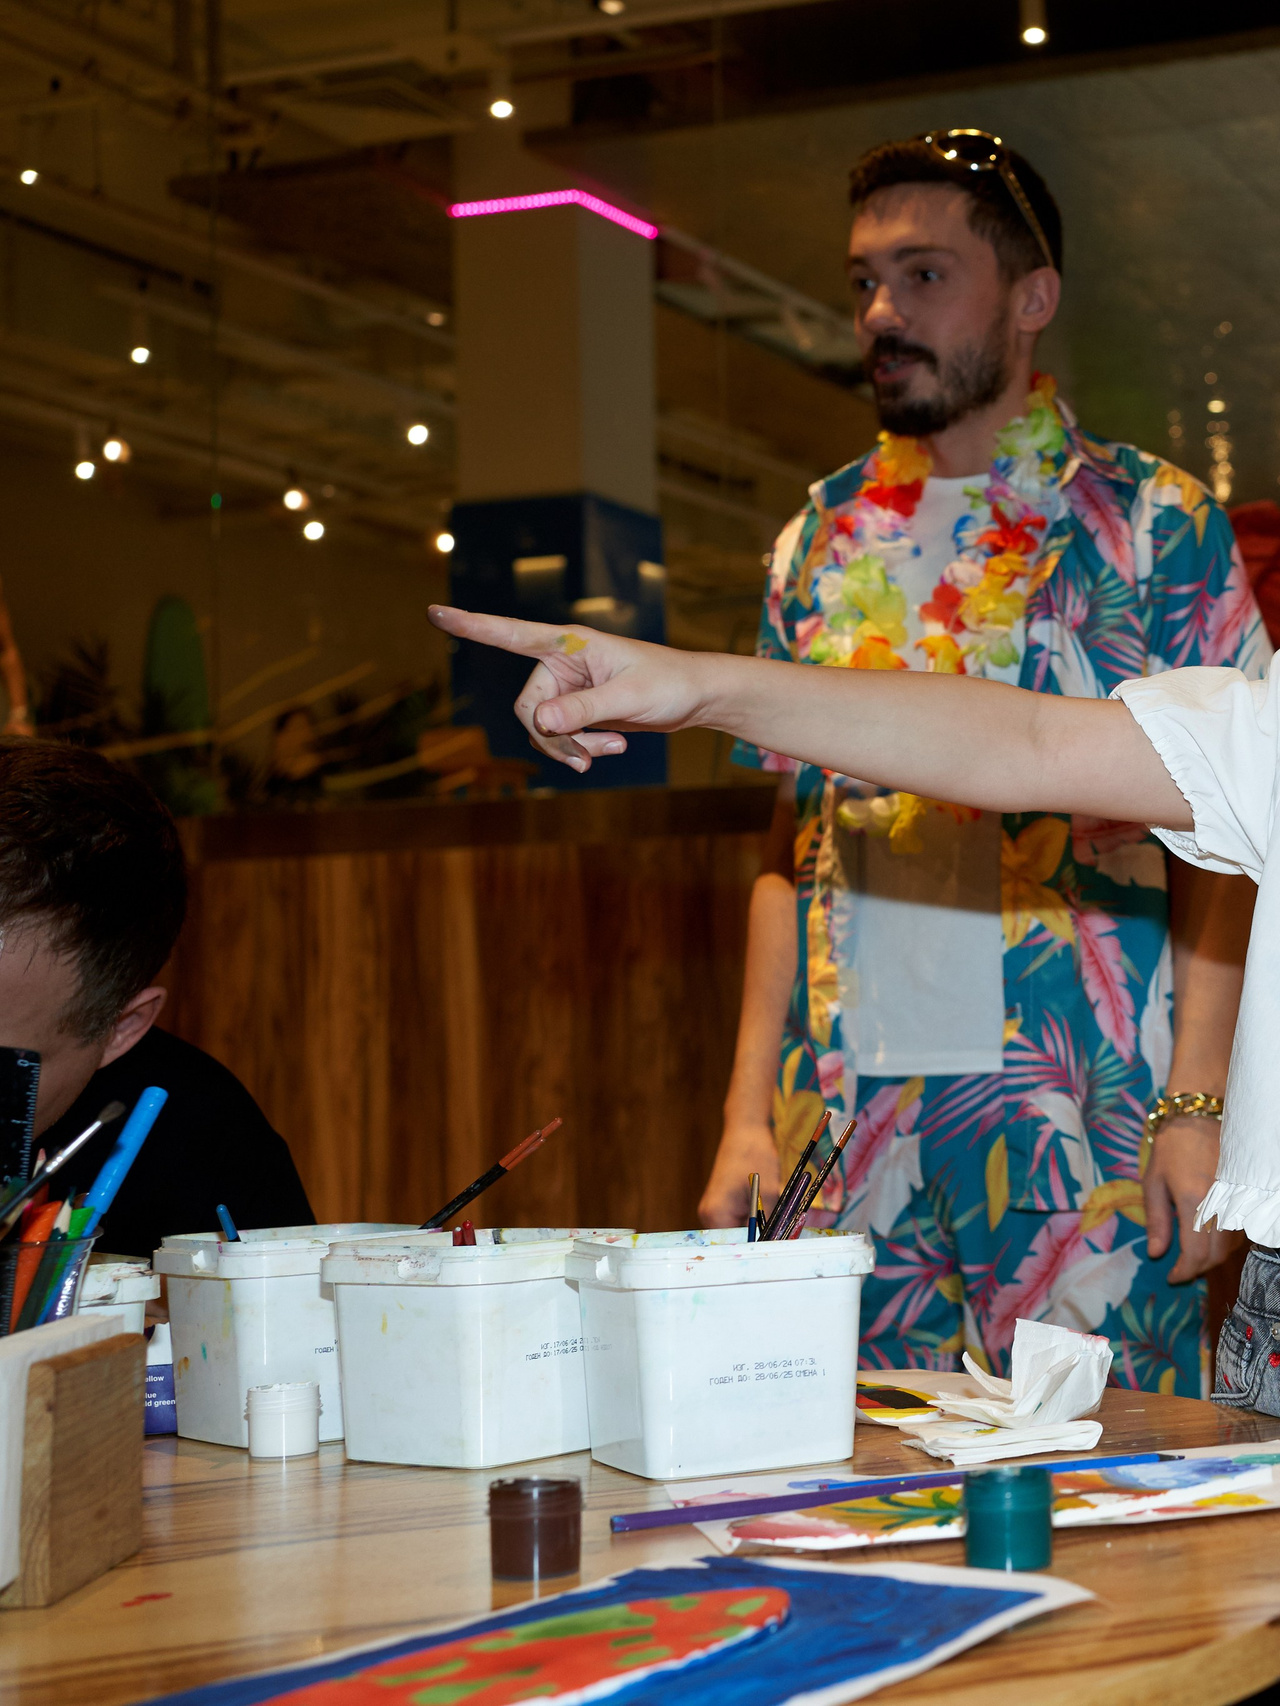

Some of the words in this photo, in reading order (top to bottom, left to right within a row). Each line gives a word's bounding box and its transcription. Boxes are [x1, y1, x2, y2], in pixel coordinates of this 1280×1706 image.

[314, 1346, 334, 1354] ГОДЕН
[754, 1360, 792, 1370] 28/06/24
[145, 1375, 165, 1383] ellow
[709, 1376, 734, 1386] ГОДЕН
[755, 1370, 793, 1381] 28/06/25
[154, 1399, 176, 1408] green
